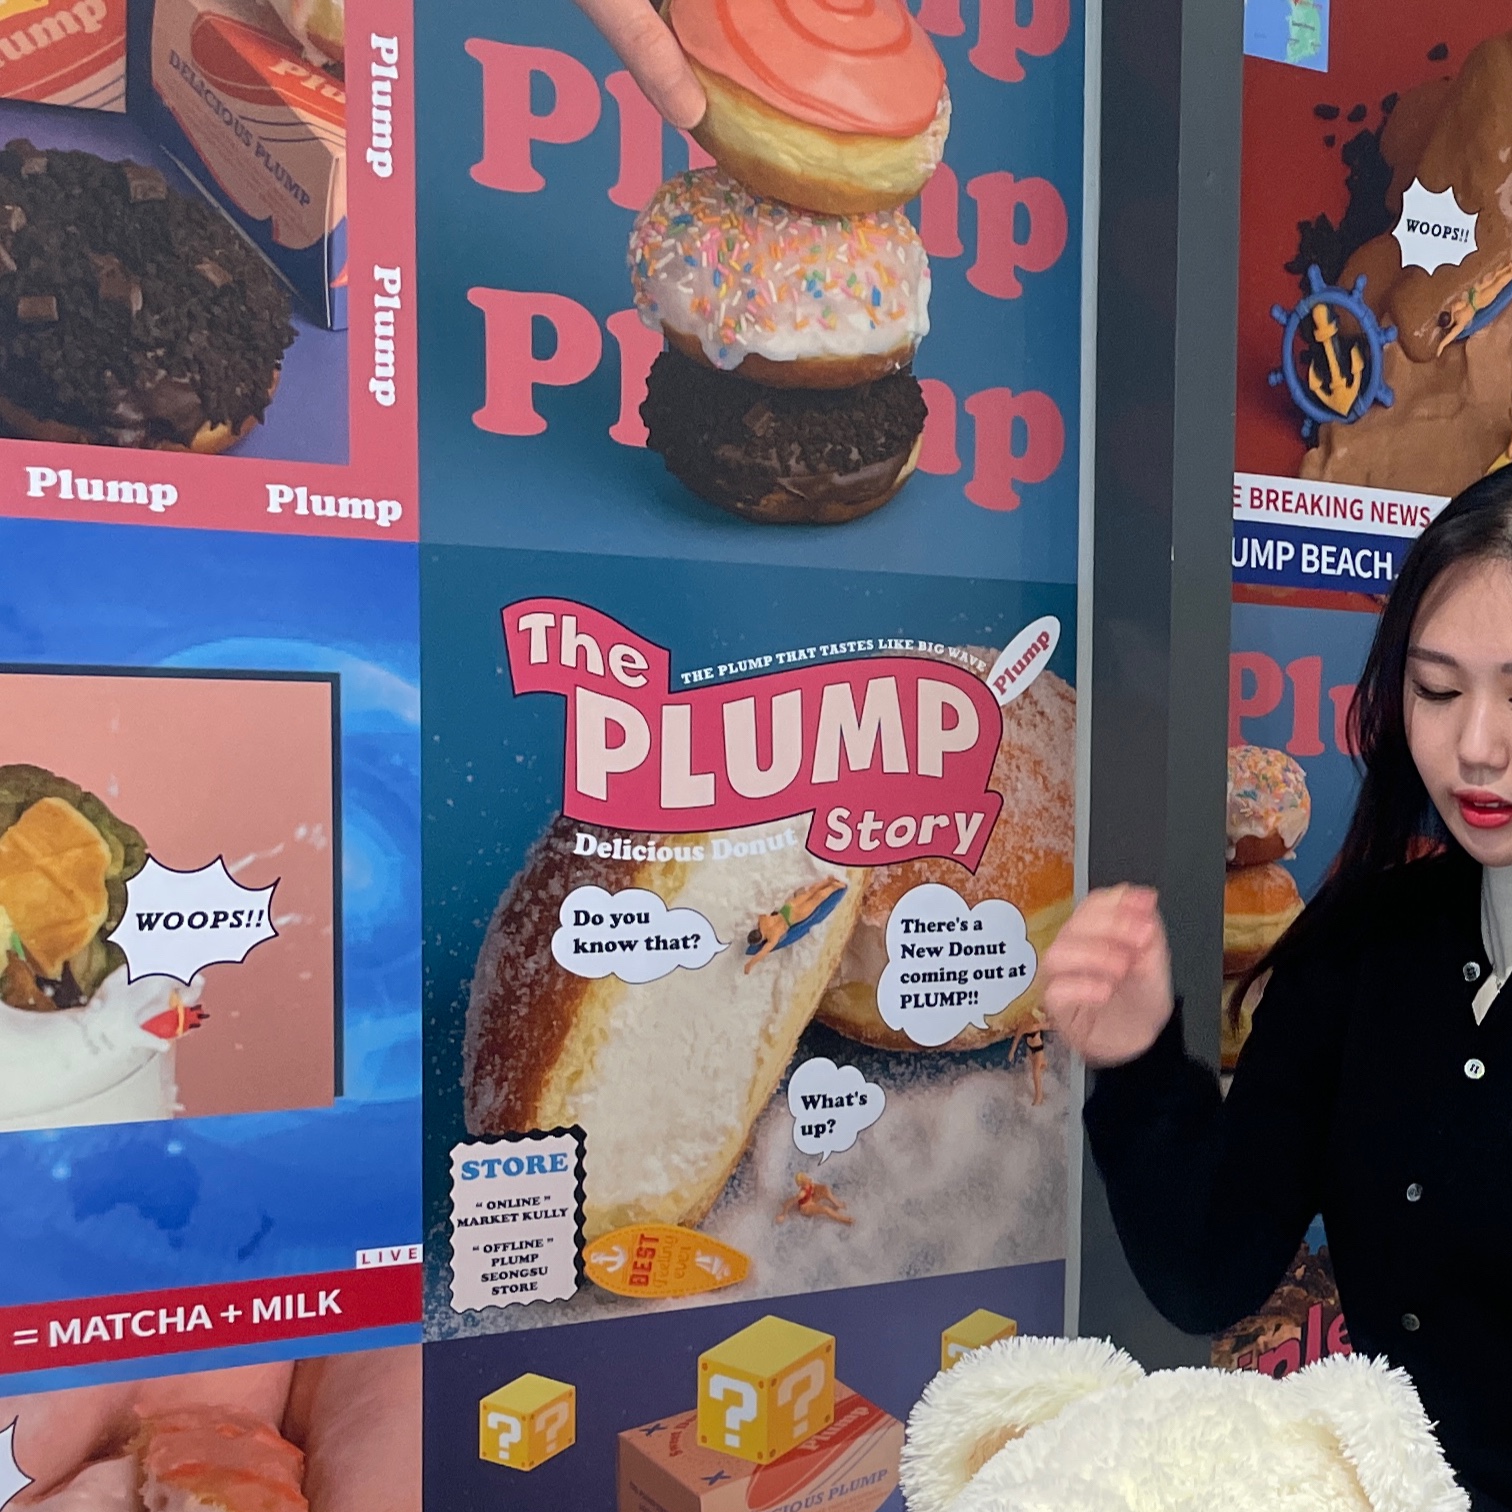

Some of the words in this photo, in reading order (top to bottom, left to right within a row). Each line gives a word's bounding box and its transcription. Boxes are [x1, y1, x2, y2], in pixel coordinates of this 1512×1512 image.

[0, 0, 107, 68] ump
[367, 33, 398, 178] Plump
[168, 49, 254, 148] DELICIOUS
[254, 141, 311, 207] PLUMP
[1406, 218, 1470, 243] WOOPS!!
[369, 265, 401, 407] Plump
[26, 467, 178, 511] Plump
[266, 484, 402, 526] Plump
[1249, 486, 1364, 522] BREAKING
[1370, 500, 1432, 529] NEWS
[516, 610, 650, 690] The
[680, 669, 714, 686] THE
[717, 653, 774, 678] PLUMP
[775, 645, 817, 667] THAT
[819, 638, 875, 656] TASTES
[877, 637, 914, 651] LIKE
[917, 639, 945, 656] BIG
[946, 645, 988, 674] WAVE
[991, 629, 1052, 696] Plump
[574, 674, 982, 810] PLUMP
[572, 830, 706, 864] Delicious
[711, 825, 798, 862] Donut
[823, 805, 986, 857] Story
[135, 908, 265, 932] WOOPS!!
[572, 908, 605, 928] Do
[608, 910, 652, 929] you
[900, 916, 969, 934] There's
[972, 919, 984, 933] a
[572, 934, 640, 956] know
[643, 931, 702, 954] that?
[900, 941, 942, 960] New
[947, 939, 1008, 959] Donut
[899, 967, 968, 988] coming
[971, 963, 1005, 982] out
[1007, 962, 1028, 979] at
[900, 989, 981, 1010] PLUMP!!
[800, 1089, 869, 1112] What's
[800, 1117, 837, 1139] up?
[460, 1152, 570, 1182] STORE
[456, 1213, 520, 1229] MARKET
[521, 1206, 570, 1222] KULLY
[360, 1245, 420, 1266] LIVE
[490, 1253, 540, 1268] PLUMP
[628, 1232, 661, 1288] BEST
[480, 1266, 550, 1283] SEONGSU
[491, 1281, 539, 1297] STORE
[48, 1303, 214, 1349] MATCHA
[251, 1287, 343, 1325] MILK
[827, 1467, 889, 1499] PLUMP
